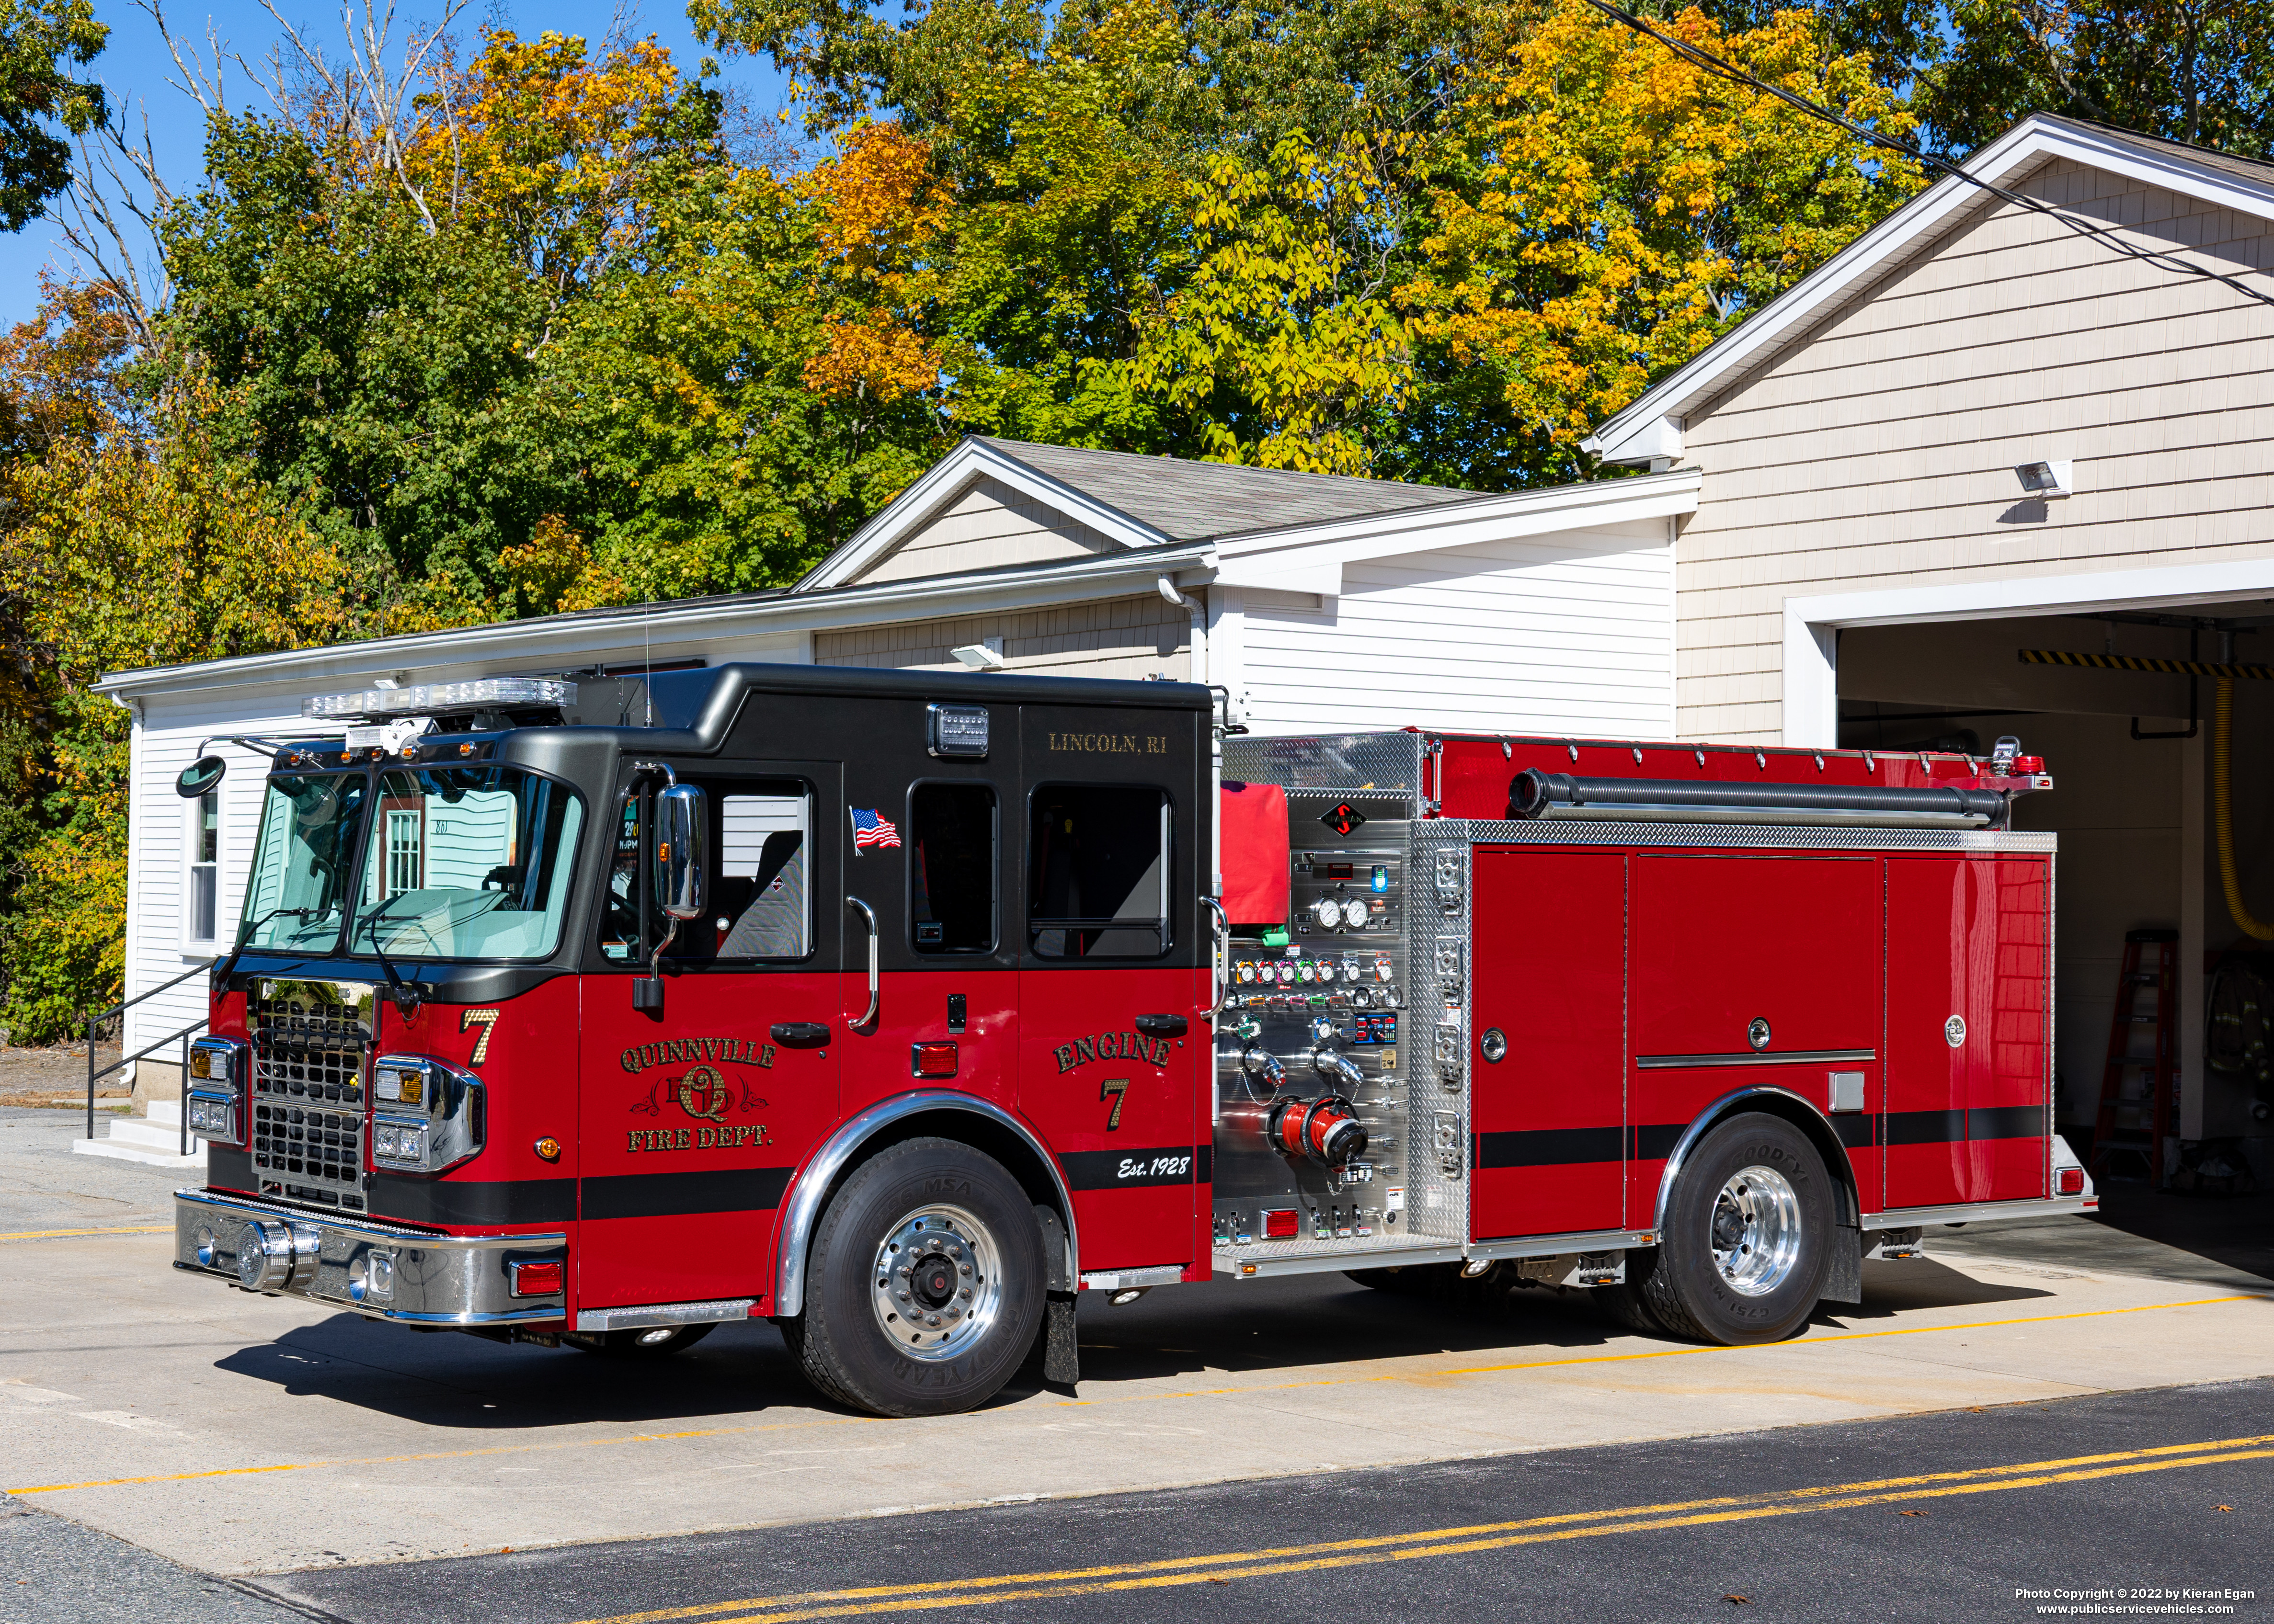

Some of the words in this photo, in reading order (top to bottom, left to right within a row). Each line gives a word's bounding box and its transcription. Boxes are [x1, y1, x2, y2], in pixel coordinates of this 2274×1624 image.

[1049, 732, 1141, 755] LINCOLN,
[1146, 736, 1167, 754] RI
[435, 819, 448, 835] 861
[459, 1009, 500, 1068] 7
[1053, 1032, 1172, 1074] ENGINE
[621, 1037, 777, 1074] QUINNVILLE
[1099, 1079, 1131, 1131] 7
[628, 1128, 691, 1152] FIRE
[698, 1124, 774, 1149] DEPT.
[1118, 1159, 1147, 1179] Est.
[1150, 1157, 1191, 1176] 1928
[923, 1178, 973, 1196] MSA
[1731, 1145, 1820, 1235] GOODYEAR
[1729, 1302, 1770, 1318] G751
[892, 1303, 1020, 1386] GOODYEAR
